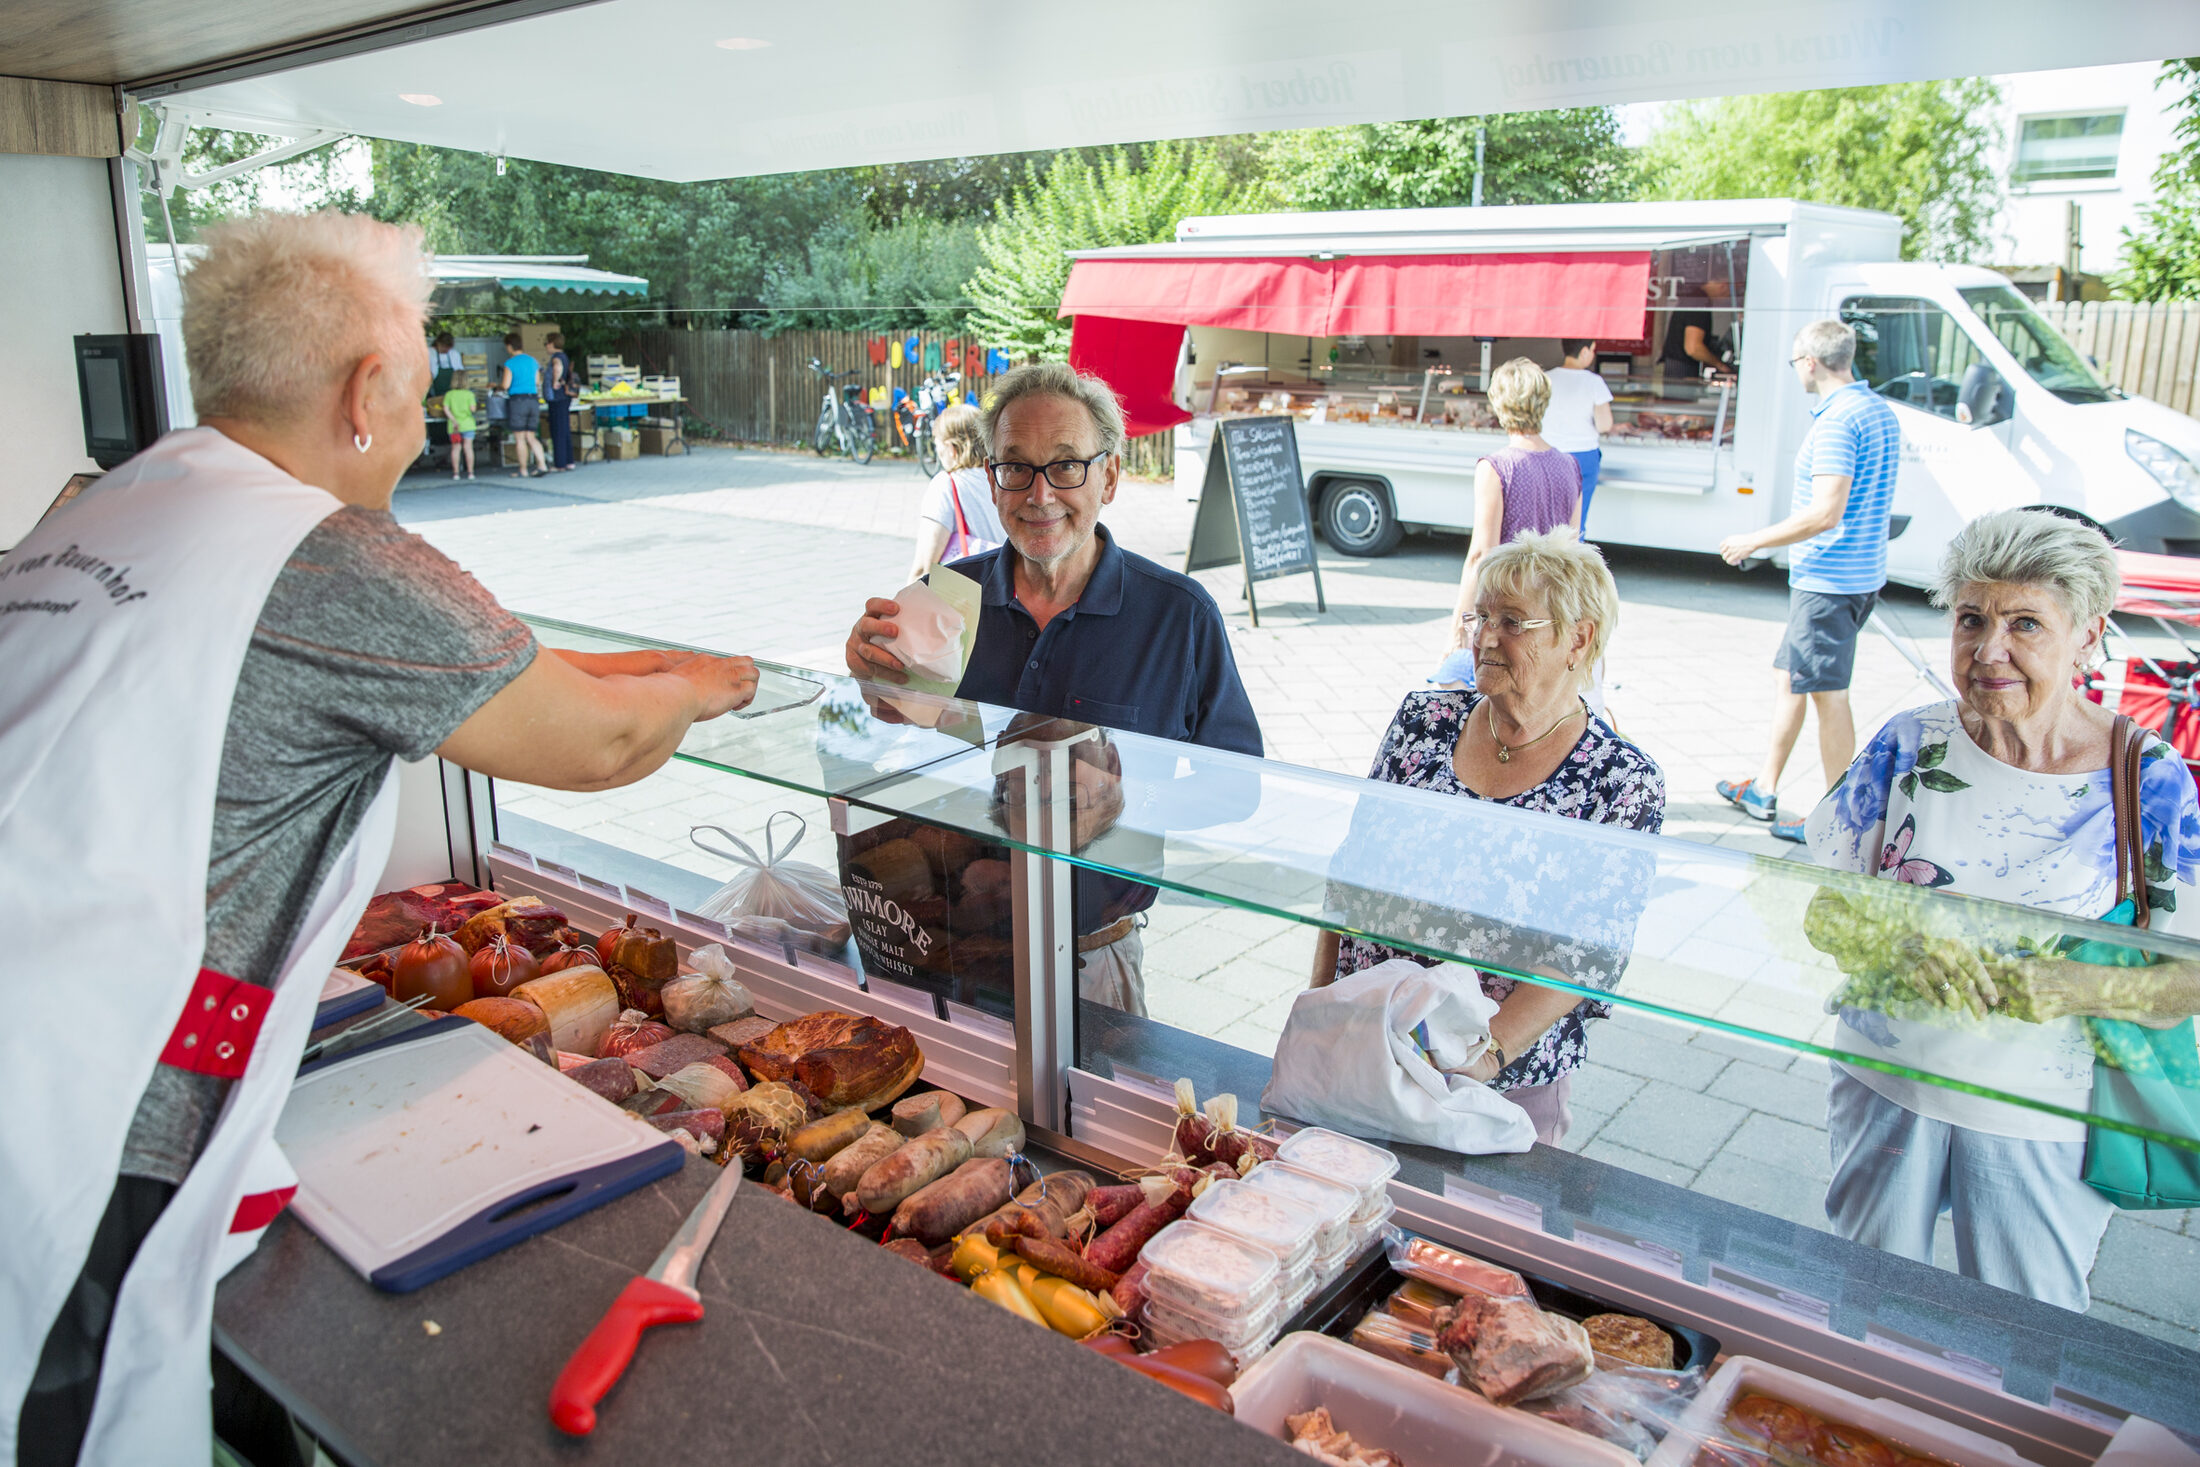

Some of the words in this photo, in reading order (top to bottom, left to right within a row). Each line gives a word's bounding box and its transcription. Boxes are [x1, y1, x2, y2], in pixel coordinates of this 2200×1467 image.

[1647, 276, 1685, 300] ST
[54, 544, 148, 606] Bauernhof
[868, 879, 883, 891] 1779
[842, 885, 933, 957] OWMORE
[862, 918, 887, 938] ISLAY
[881, 941, 905, 959] MALT
[880, 953, 914, 976] WHISKY
